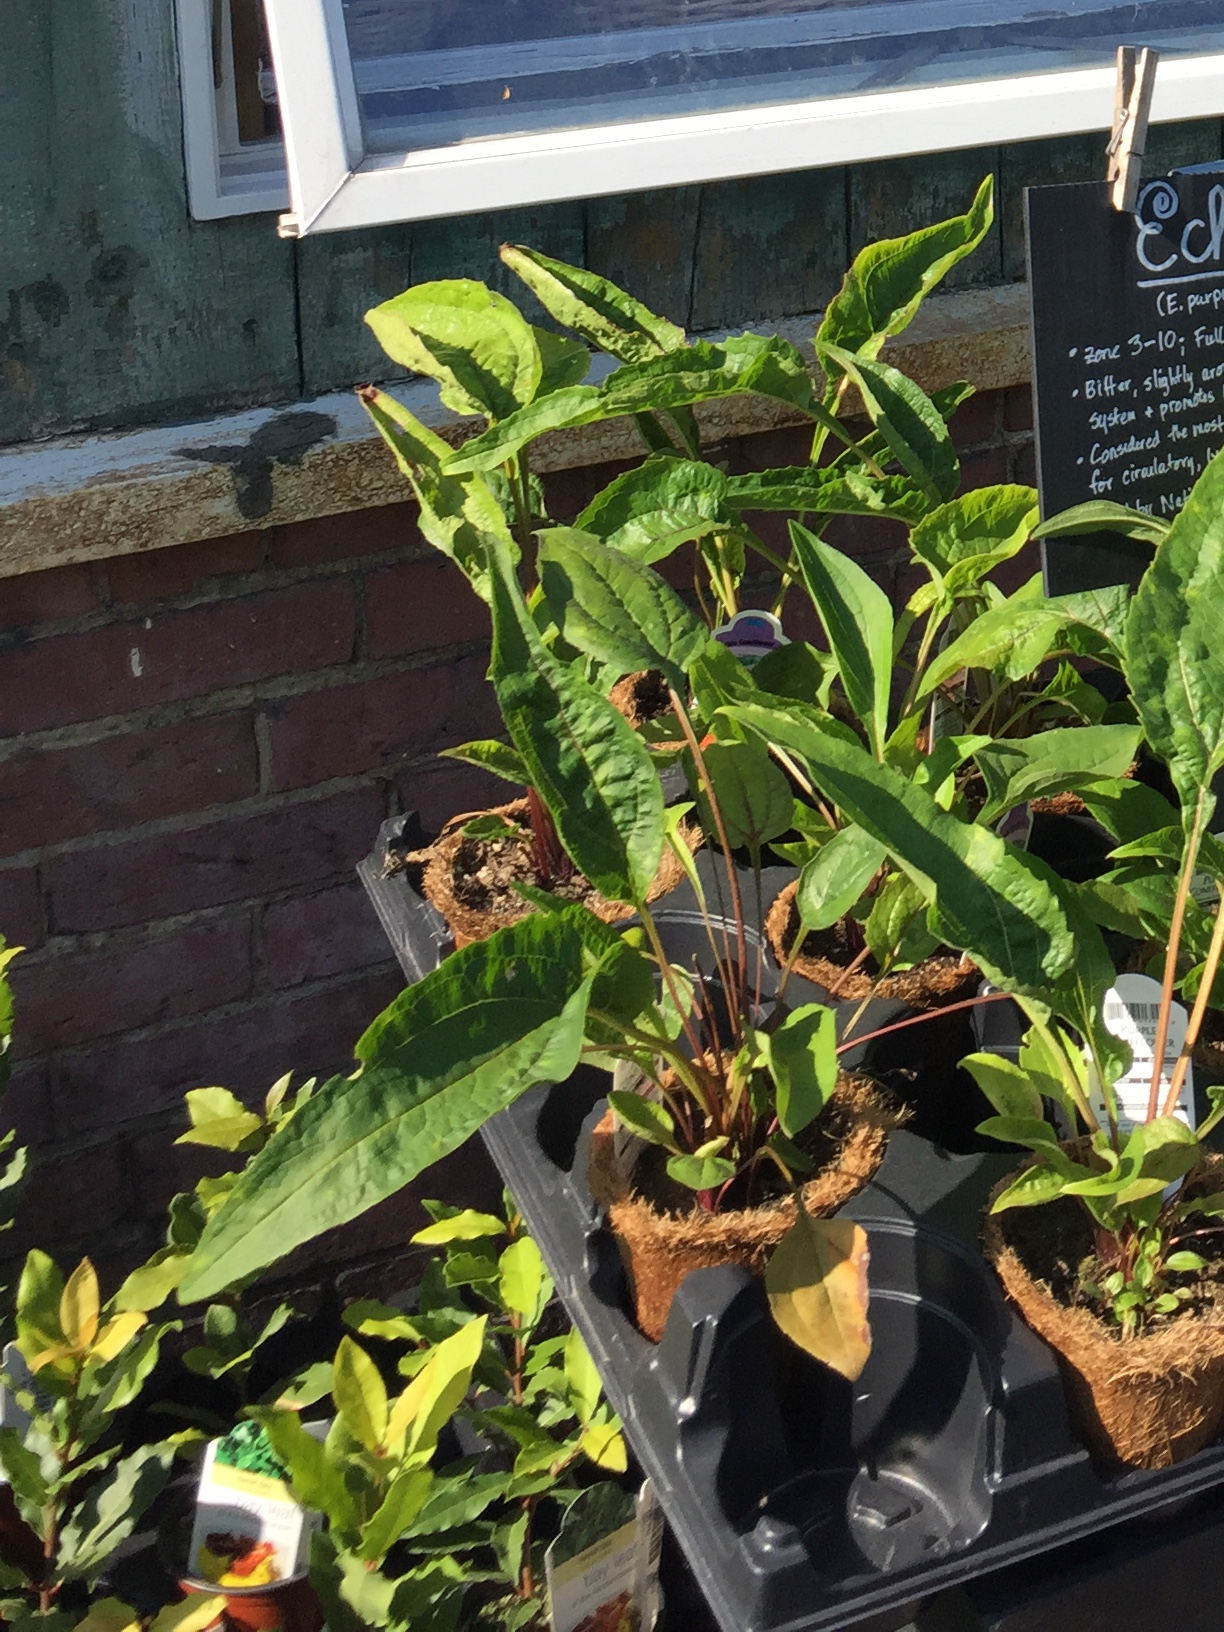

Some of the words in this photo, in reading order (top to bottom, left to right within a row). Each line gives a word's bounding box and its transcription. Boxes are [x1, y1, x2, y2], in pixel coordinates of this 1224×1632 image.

[1084, 374, 1138, 400] Bitter,
[1143, 364, 1194, 397] slightly
[1159, 387, 1216, 421] promotes
[1089, 429, 1161, 466] Considered
[1167, 423, 1188, 443] the
[1088, 468, 1113, 496] for
